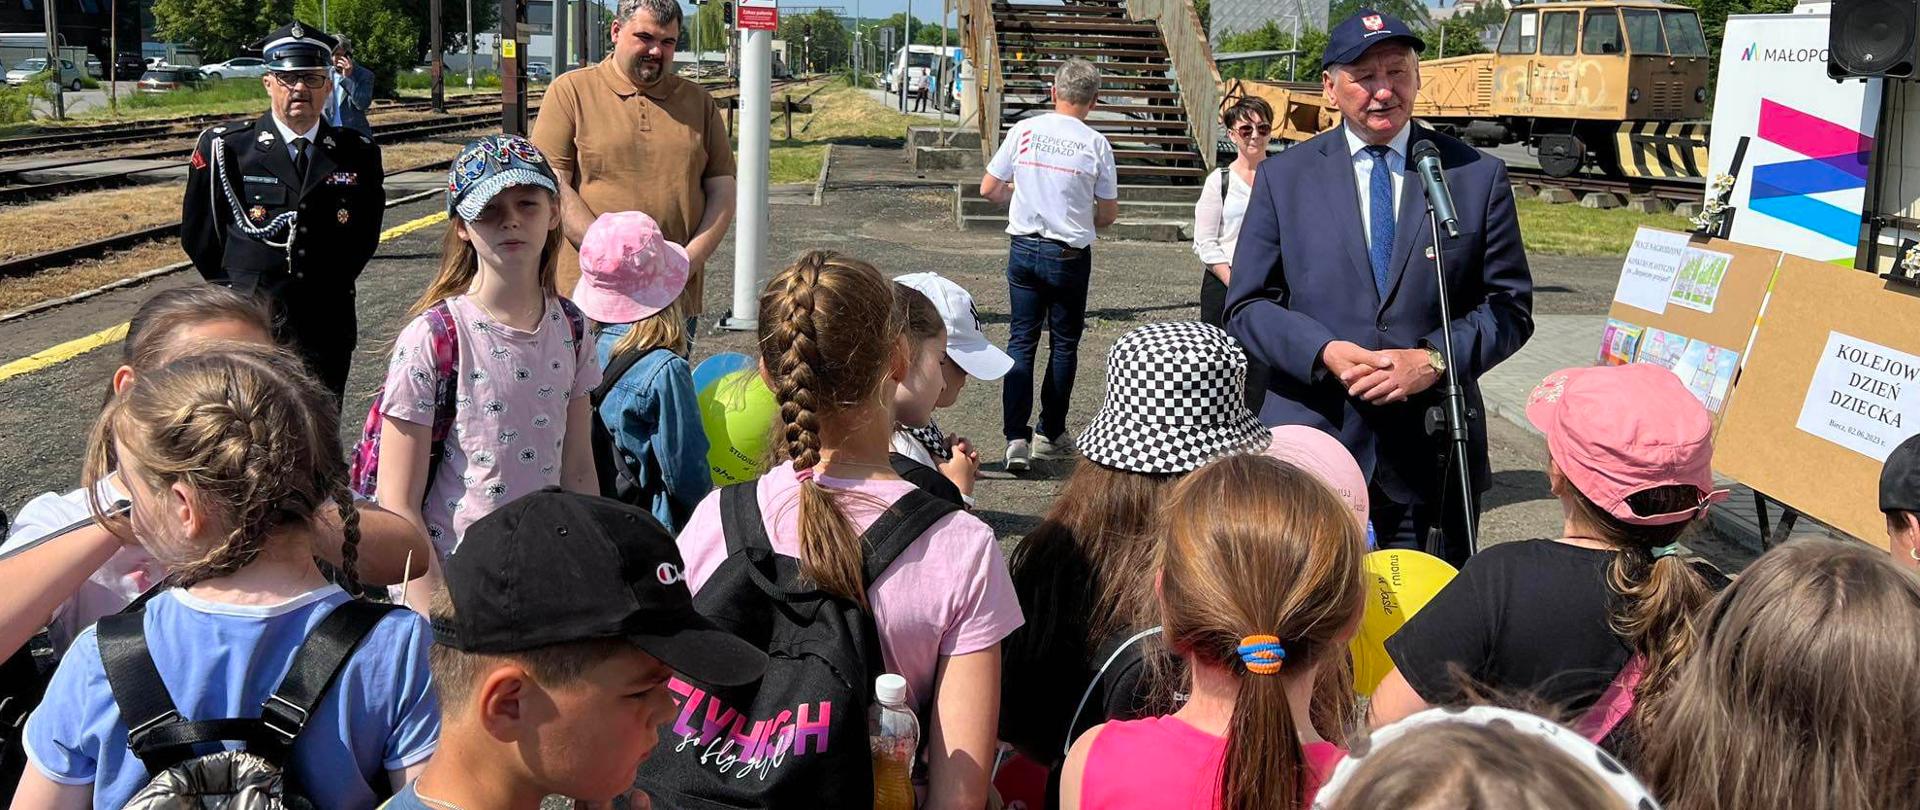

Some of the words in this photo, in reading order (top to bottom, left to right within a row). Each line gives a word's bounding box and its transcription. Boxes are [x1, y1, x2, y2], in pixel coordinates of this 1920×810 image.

[1030, 142, 1074, 156] PRZEJAZD
[1032, 134, 1086, 150] BEZPIECZNY
[1836, 344, 1920, 382] KOLEJOW
[1848, 372, 1902, 402] DZIEŃ
[1829, 390, 1902, 428] DZIECKA
[1848, 427, 1880, 445] 02.06.2023
[1390, 554, 1402, 587] STUDIUJ
[1380, 588, 1398, 616] Jaśle
[676, 732, 701, 752] so
[700, 737, 738, 773] fly
[736, 734, 790, 780] girl
